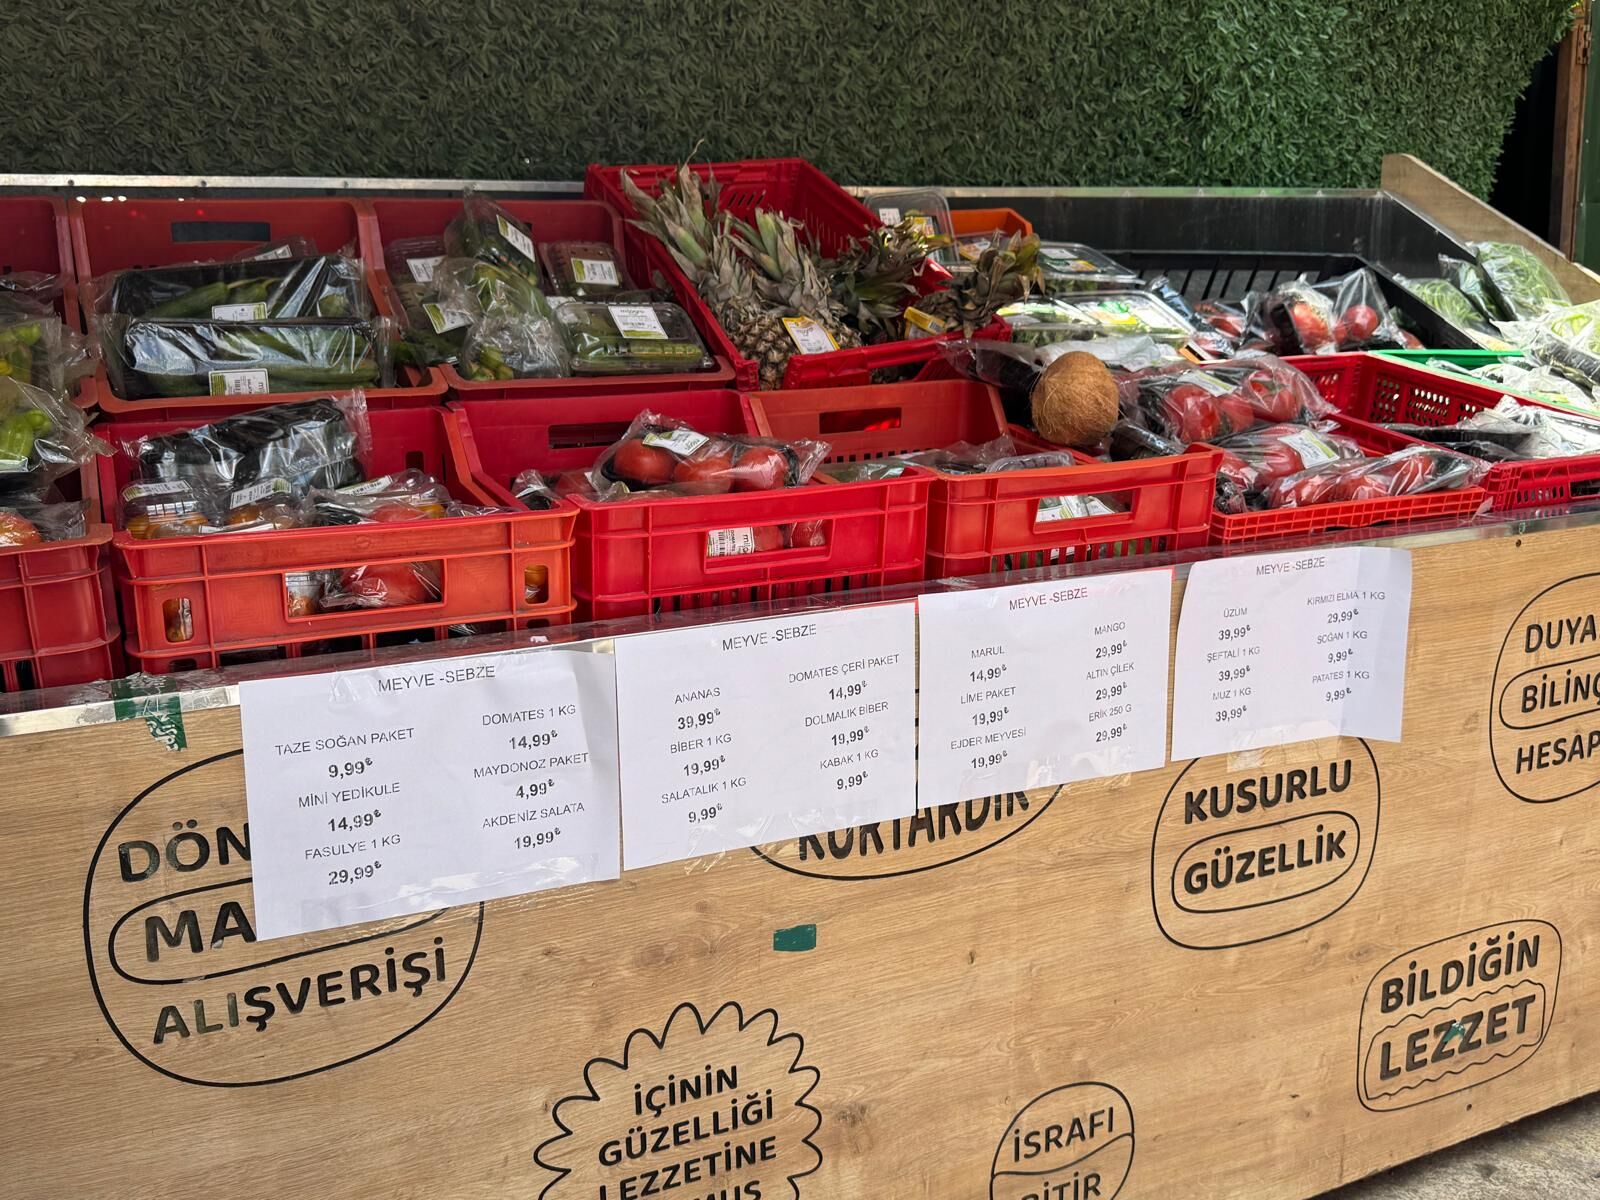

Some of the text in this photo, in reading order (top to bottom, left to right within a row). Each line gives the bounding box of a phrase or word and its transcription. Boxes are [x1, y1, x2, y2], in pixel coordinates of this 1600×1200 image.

[1256, 556, 1325, 576] MEYVE -SEBZE
[1009, 586, 1089, 611] MEYVE -SEBZE
[1336, 591, 1359, 603] ELMA
[1362, 591, 1366, 600] 1
[1370, 591, 1386, 600] KG
[1223, 606, 1248, 618] ÜZÜM
[722, 624, 817, 652] MEYVE -SEBZE
[1094, 621, 1126, 636] MANGO
[1317, 630, 1368, 645] SOĞAN 1 KG
[971, 645, 1005, 659] MARUL
[1206, 646, 1260, 663] ŞEFTALİ 1 KG
[378, 665, 496, 693] MEYVE -SEBZE
[788, 653, 901, 684] DOMATES ÇERİ PAKET
[1086, 662, 1135, 681] ALTIN ÇİLEK
[1312, 671, 1370, 684] PATATES 1 KG
[674, 687, 721, 705] ANANAS
[960, 686, 1017, 705] LİME PAKET
[1212, 688, 1231, 701] MUZ
[1239, 687, 1251, 697] KG
[482, 704, 576, 727] DOMATES 1 KG
[804, 701, 889, 728] DOLMALIK BİBER
[1088, 703, 1132, 722] ERİK 250 G
[275, 728, 415, 757] TAZE SOĞAN PAKET
[508, 730, 559, 751] 14,99₺
[670, 733, 732, 755] BİBER 1 KG
[950, 726, 1027, 751] EJDER MEYVESİ
[820, 749, 879, 770] KABAK 1 KG
[1516, 730, 1600, 774] HESAP
[328, 757, 373, 779] 9,99₺
[474, 753, 589, 779] MAYDONOZ PAKET
[298, 782, 401, 809] MİNİ YEDİKULE
[516, 779, 556, 800] 4,99₺
[661, 776, 747, 804] SALATALIK 1 KG
[1184, 759, 1352, 825] KUSURLU
[328, 810, 382, 832] 14,99₺
[482, 802, 585, 830] AKDENİZ SALATA
[304, 834, 402, 861] FASULYE 1 KG
[514, 827, 562, 850] 19,99₺
[1183, 824, 1347, 895] GÜZELLİK
[328, 861, 383, 886] 29,99₺
[1380, 931, 1540, 1014] BİLDİĞİN
[153, 936, 446, 1045] ALIŞVERİŞİ
[1379, 994, 1536, 1081] LEZZET
[634, 1064, 738, 1117] İÇİNİN
[598, 1088, 774, 1167] GÜZELLİĞİ
[1014, 1106, 1113, 1162] İSRAFI
[1022, 1171, 1101, 1200] İTİR
